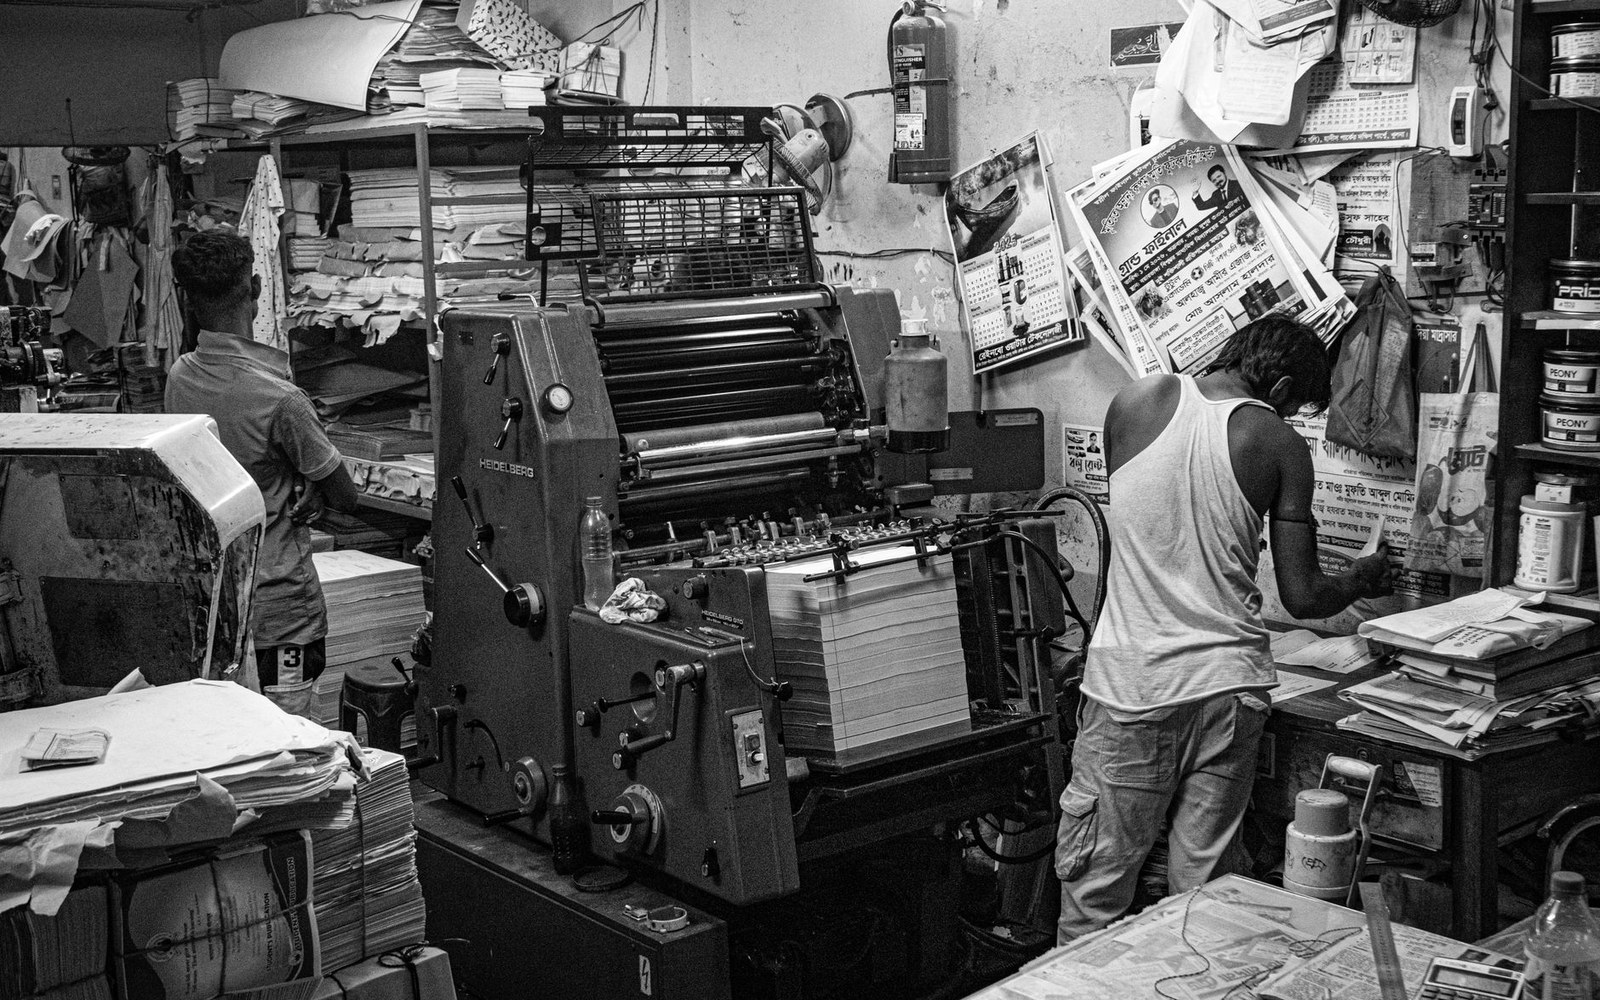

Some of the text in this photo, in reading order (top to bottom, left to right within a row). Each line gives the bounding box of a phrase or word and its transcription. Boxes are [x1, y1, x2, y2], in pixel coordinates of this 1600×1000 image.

[1143, 219, 1186, 254] ফাইনাল
[1241, 254, 1274, 280] হালদার
[1550, 368, 1578, 379] PEONY
[1556, 417, 1588, 428] PEONY
[479, 457, 534, 478] HEIDELBERG
[1393, 489, 1415, 504] মোমি
[283, 646, 301, 668] 3
[263, 892, 273, 939] PUBLCATION
